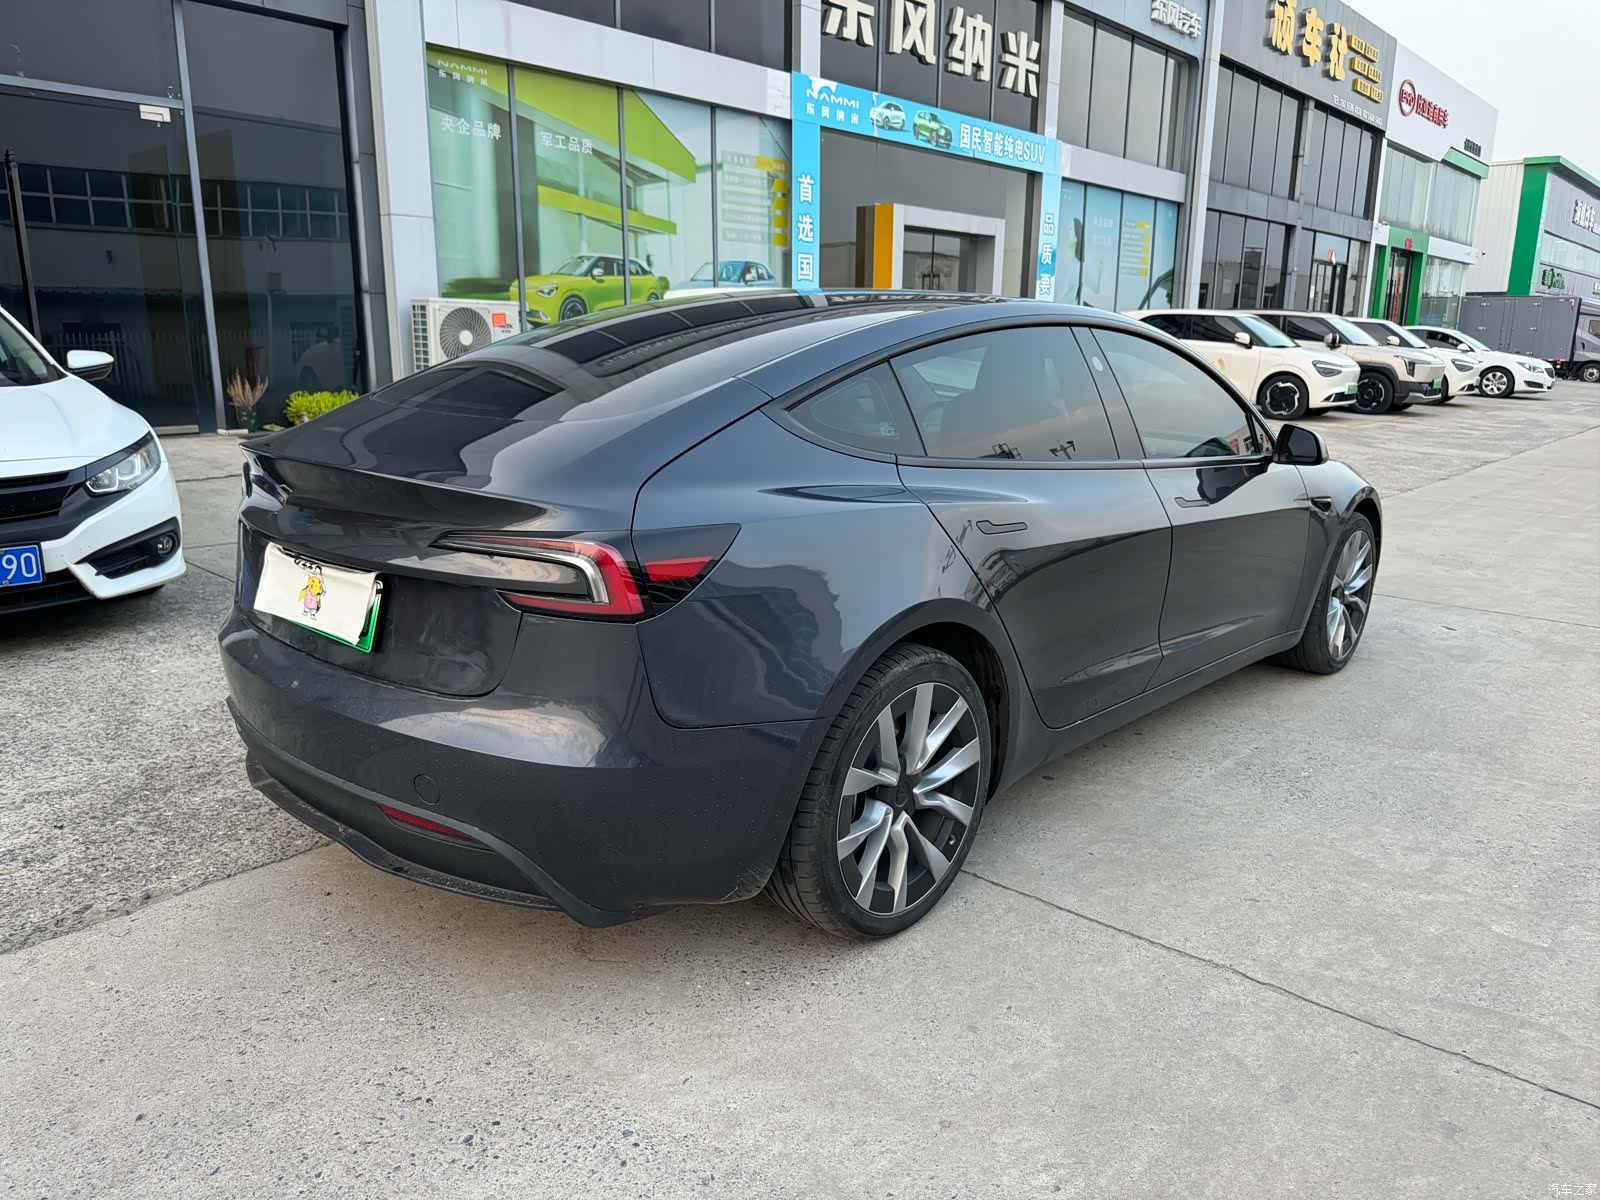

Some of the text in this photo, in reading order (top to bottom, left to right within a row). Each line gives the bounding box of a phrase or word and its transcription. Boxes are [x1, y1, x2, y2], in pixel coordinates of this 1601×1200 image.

[806, 88, 860, 109] NAMMI
[806, 102, 859, 125] 东风纳米
[441, 114, 502, 140] 央企品牌
[540, 131, 593, 155] 军工品质
[959, 122, 1047, 164] 国民智能纯电SUV
[797, 174, 815, 282] 首选国
